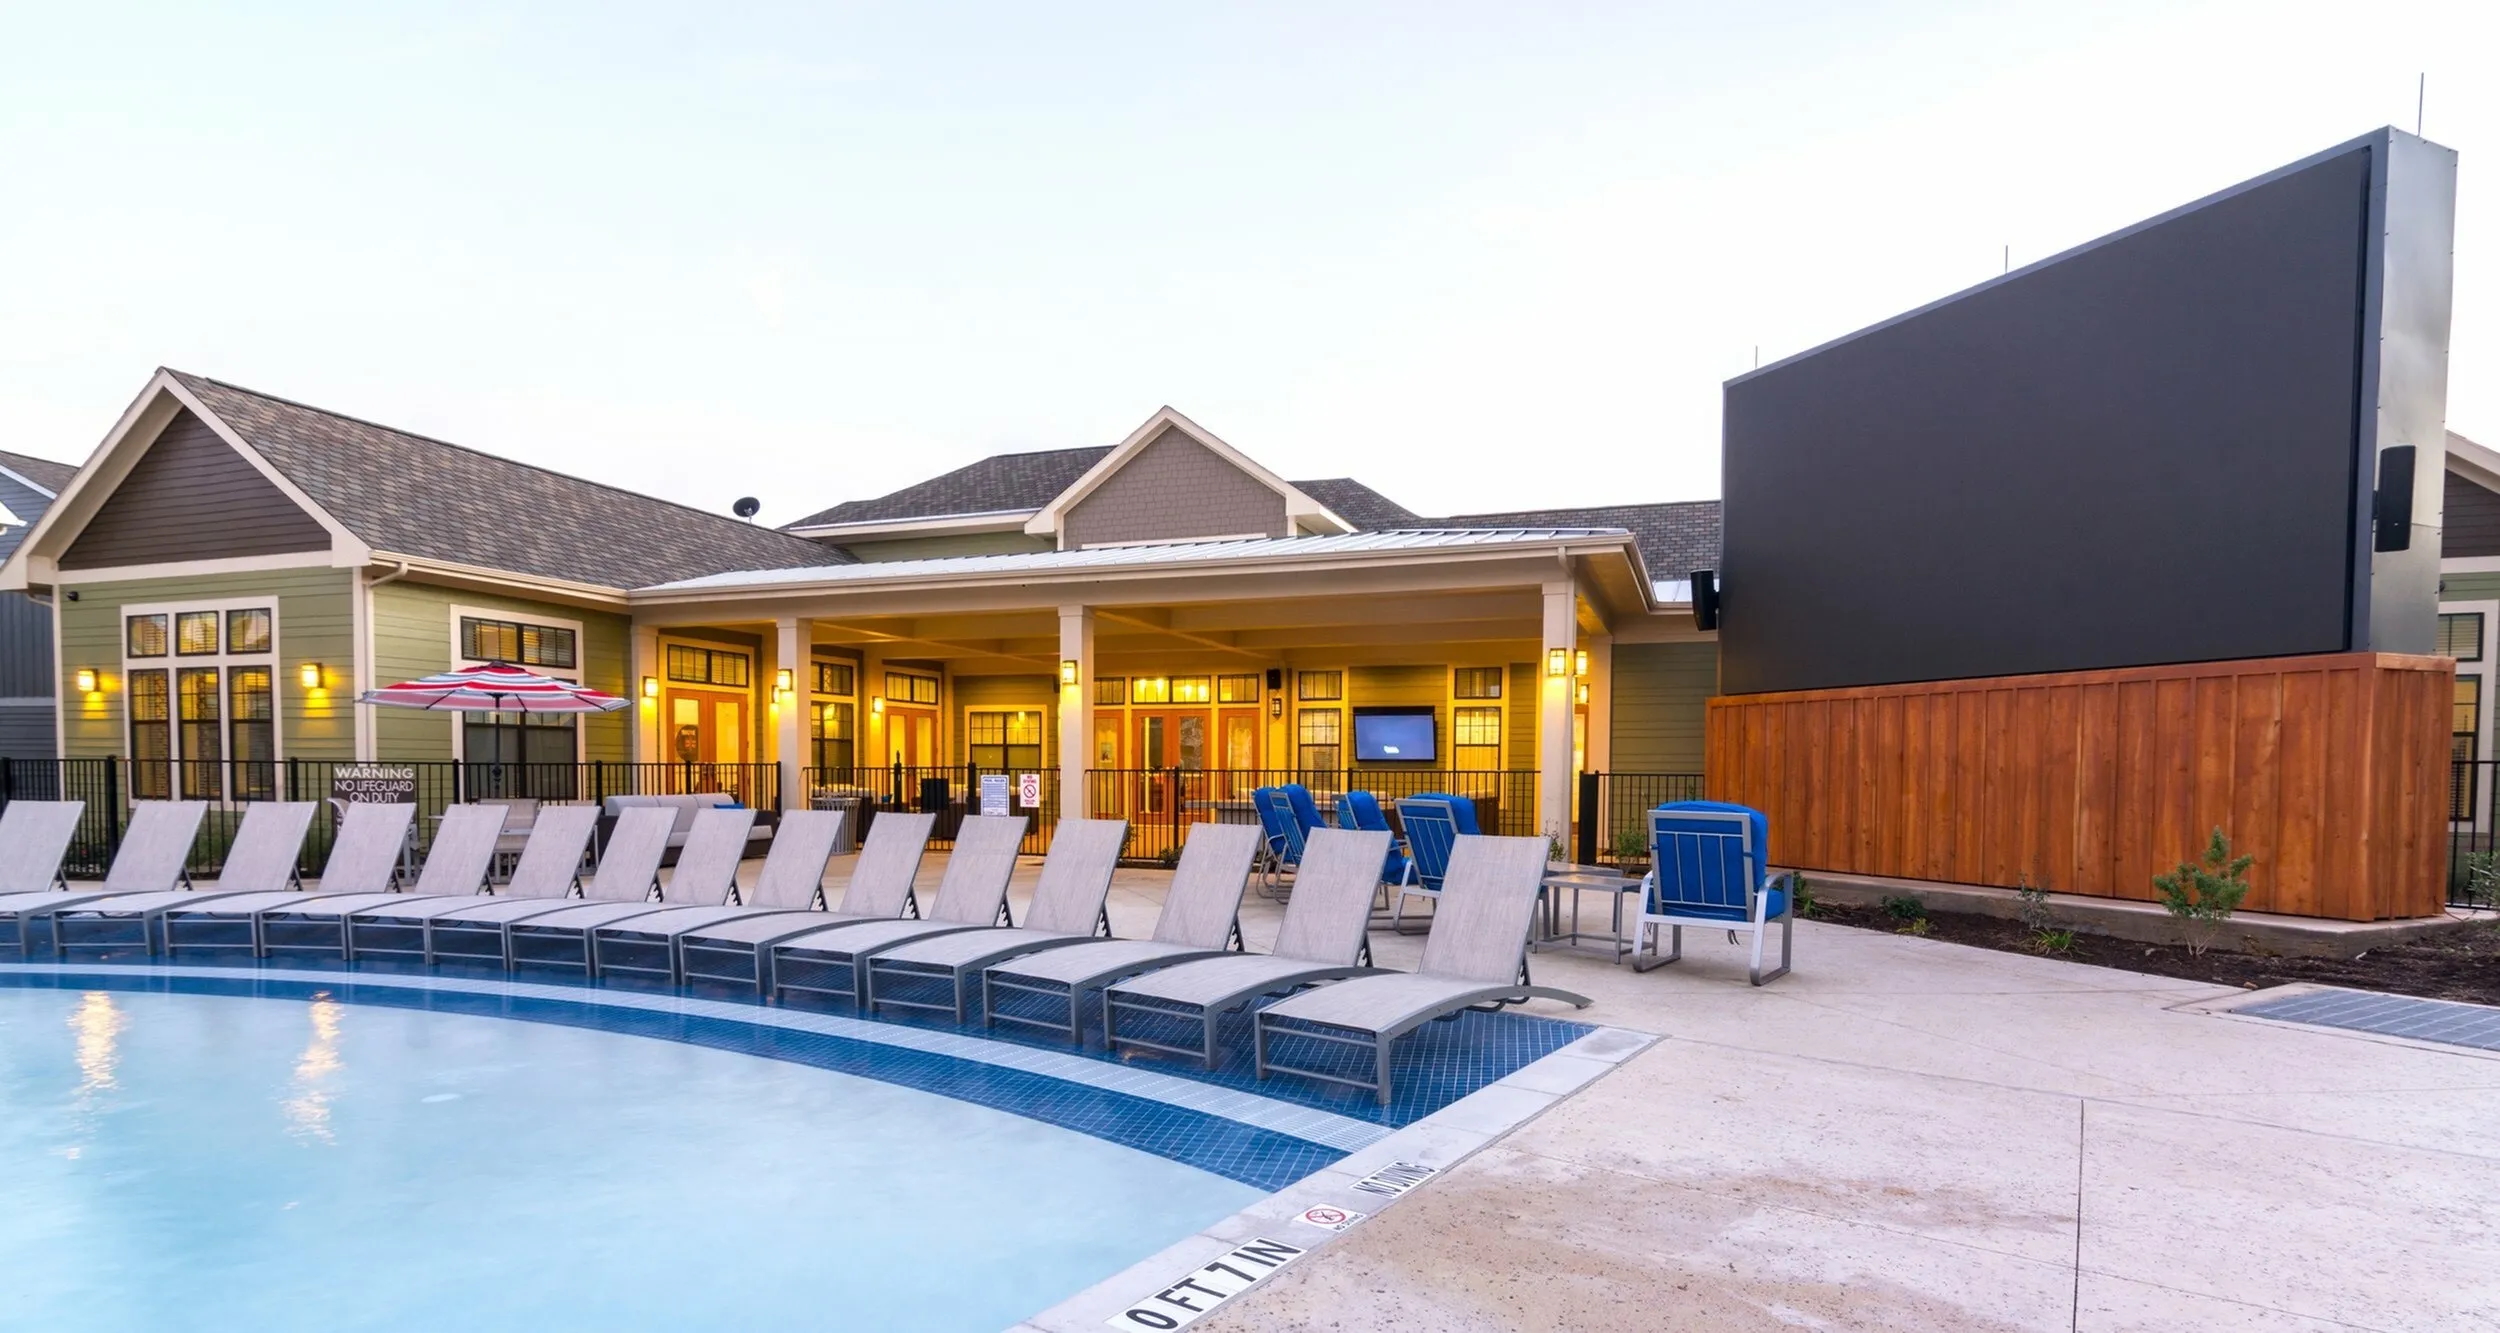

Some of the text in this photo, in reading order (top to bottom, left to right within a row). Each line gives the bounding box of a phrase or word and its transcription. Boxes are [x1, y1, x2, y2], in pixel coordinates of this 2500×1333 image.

[335, 767, 414, 779] WARNING
[335, 780, 414, 792] NO LIFEGUARD
[349, 792, 400, 803] ON DUTY
[1353, 1162, 1436, 1198] NO DIVING
[1154, 1277, 1228, 1313] FT
[1204, 1261, 1257, 1283] 7
[1231, 1238, 1302, 1268] IN
